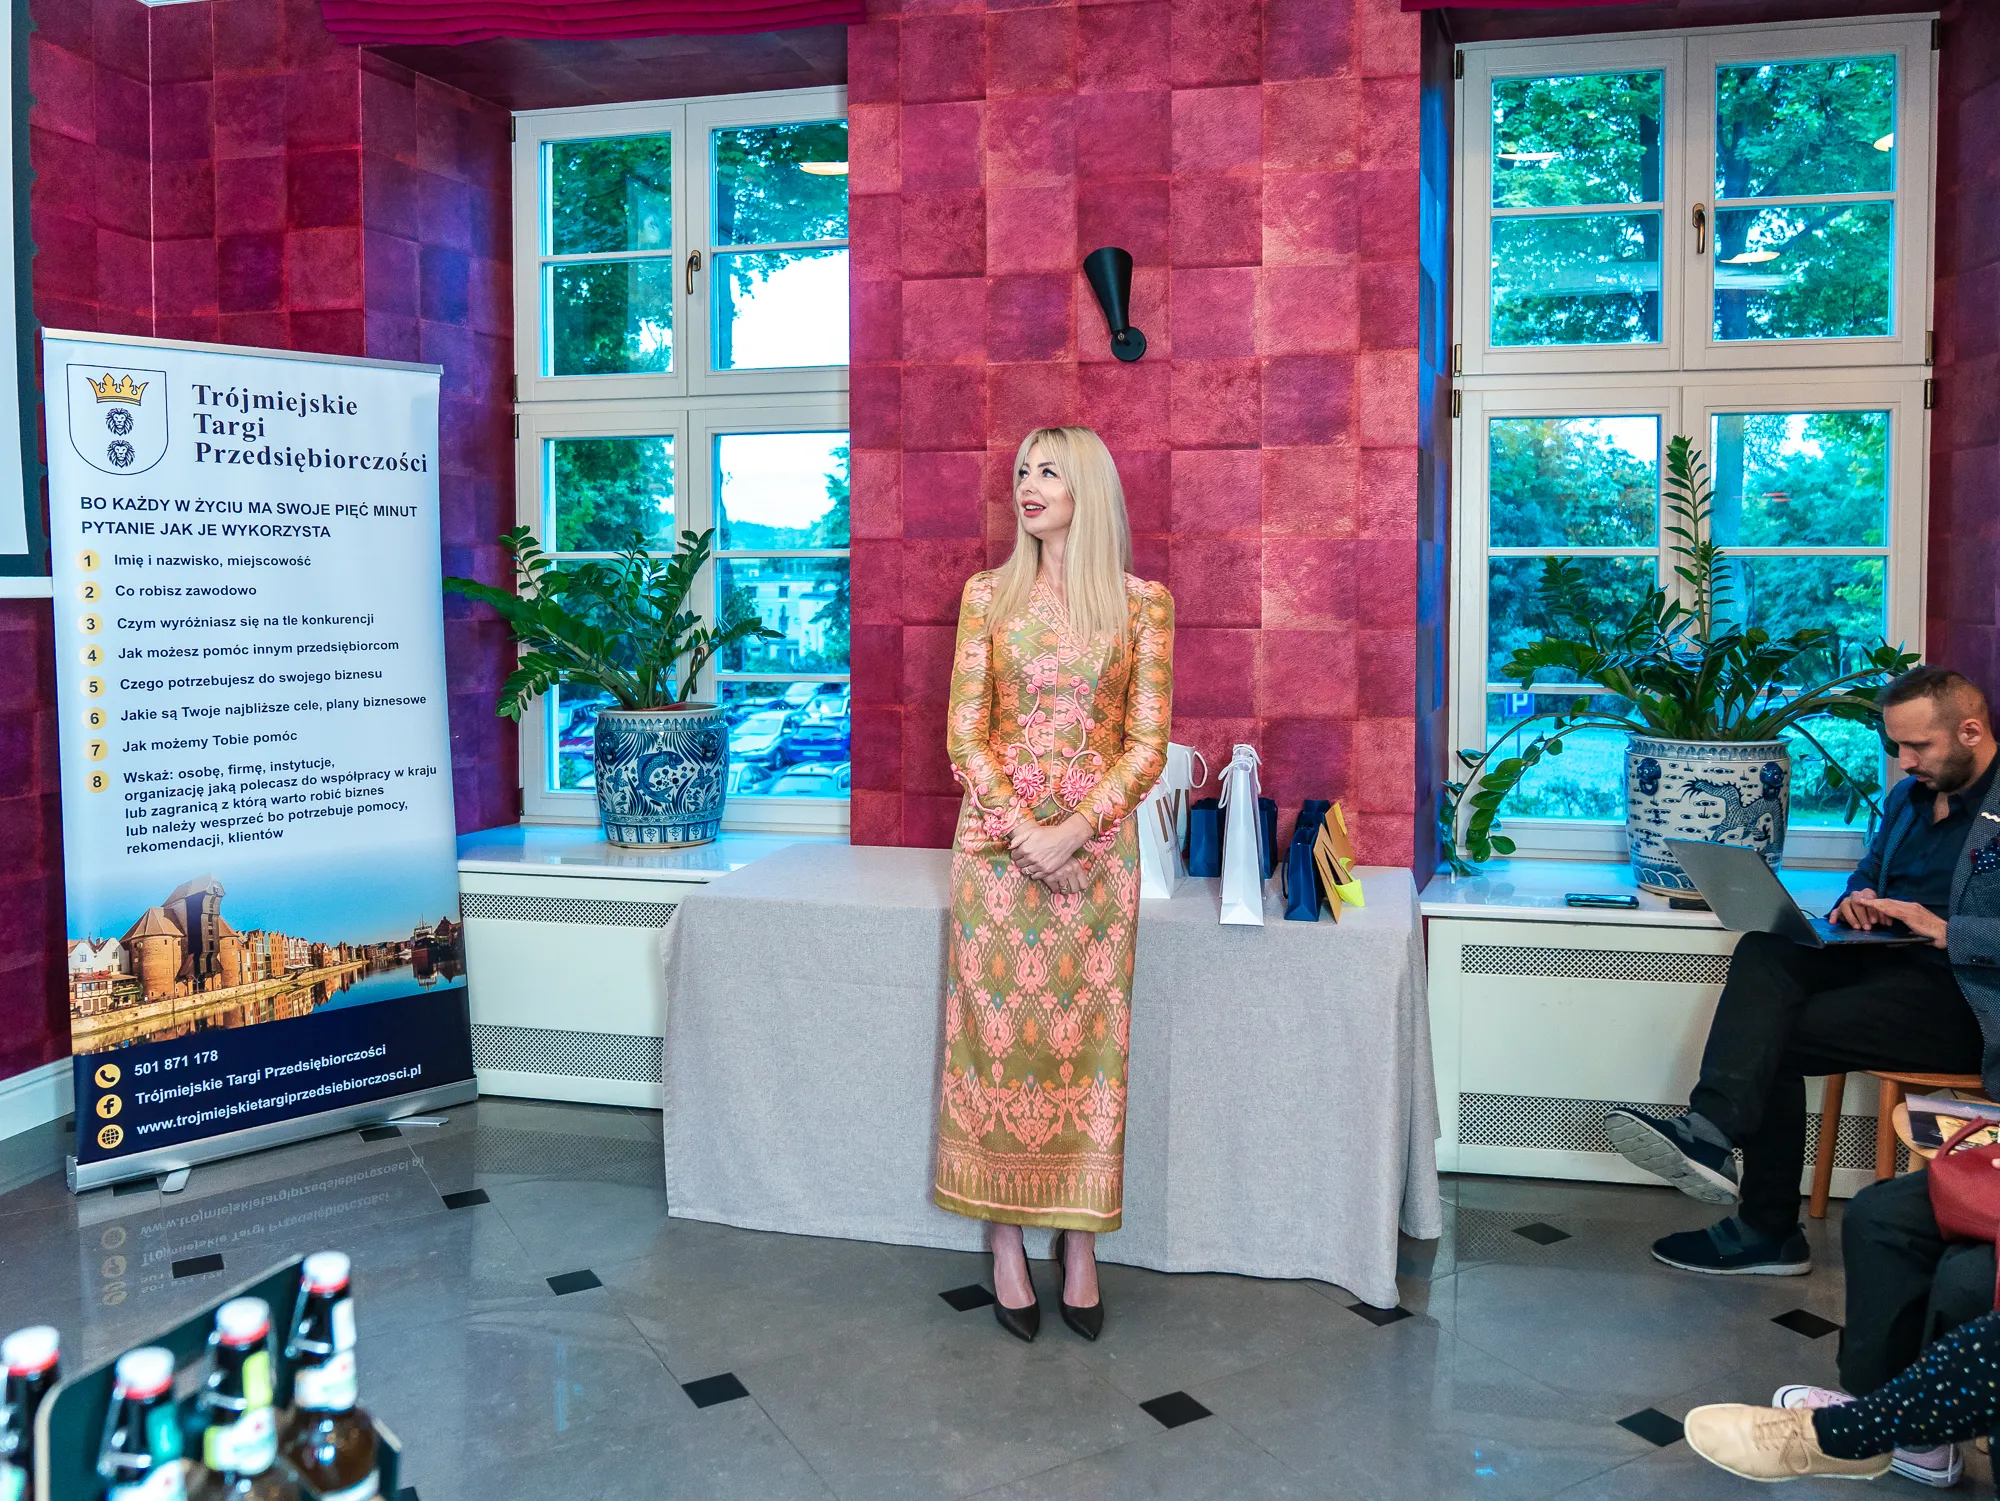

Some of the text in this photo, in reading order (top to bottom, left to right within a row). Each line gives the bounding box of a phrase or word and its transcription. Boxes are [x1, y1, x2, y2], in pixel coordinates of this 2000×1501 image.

[192, 384, 357, 417] Trójmiejskie
[193, 413, 265, 442] Targi
[195, 442, 427, 473] Przedsiębiorczości
[81, 495, 417, 519] BO KAŻDY W ŻYCIU MA SWOJE PIĘĆ MINUT
[82, 521, 331, 537] PYTANIE JAK JE WYKORZYSTA
[84, 554, 311, 568] 1 Imię i nazwisko, miejscowość
[85, 585, 257, 598] 2 Co robisz zawodowo
[86, 613, 374, 631] 3 Czym wyróżniasz się na tle konkurencji
[88, 641, 399, 661] 4 Jak możesz pomóc innym przedsiębiorcom
[89, 670, 382, 693] 5 Czego potrzebujesz do swojego biznesu
[90, 696, 426, 725] 6 Jakie są Twoje najbliższe cele, plany biznesowe
[91, 730, 297, 756] 7 Jak możemy Tobie pomóc
[93, 757, 335, 788] 8 Wskaż: osobę, firmę, instytucje,
[125, 765, 436, 803] organizację jaką polecasz do współpracy w kraju
[126, 787, 384, 819] lub zagranicą z którą warto robić biznes
[126, 801, 408, 836] lub należy wesprzeć bo potrzebuje pomocy,
[127, 828, 283, 854] rekomendacji, klientów
[134, 1050, 218, 1076] 501 871 178
[136, 1044, 386, 1104] Trójmiejskie Targi Przedsiębiorczości
[137, 1063, 422, 1136] www.trojmiejskietargiprzedsiebiorczosci.pl
